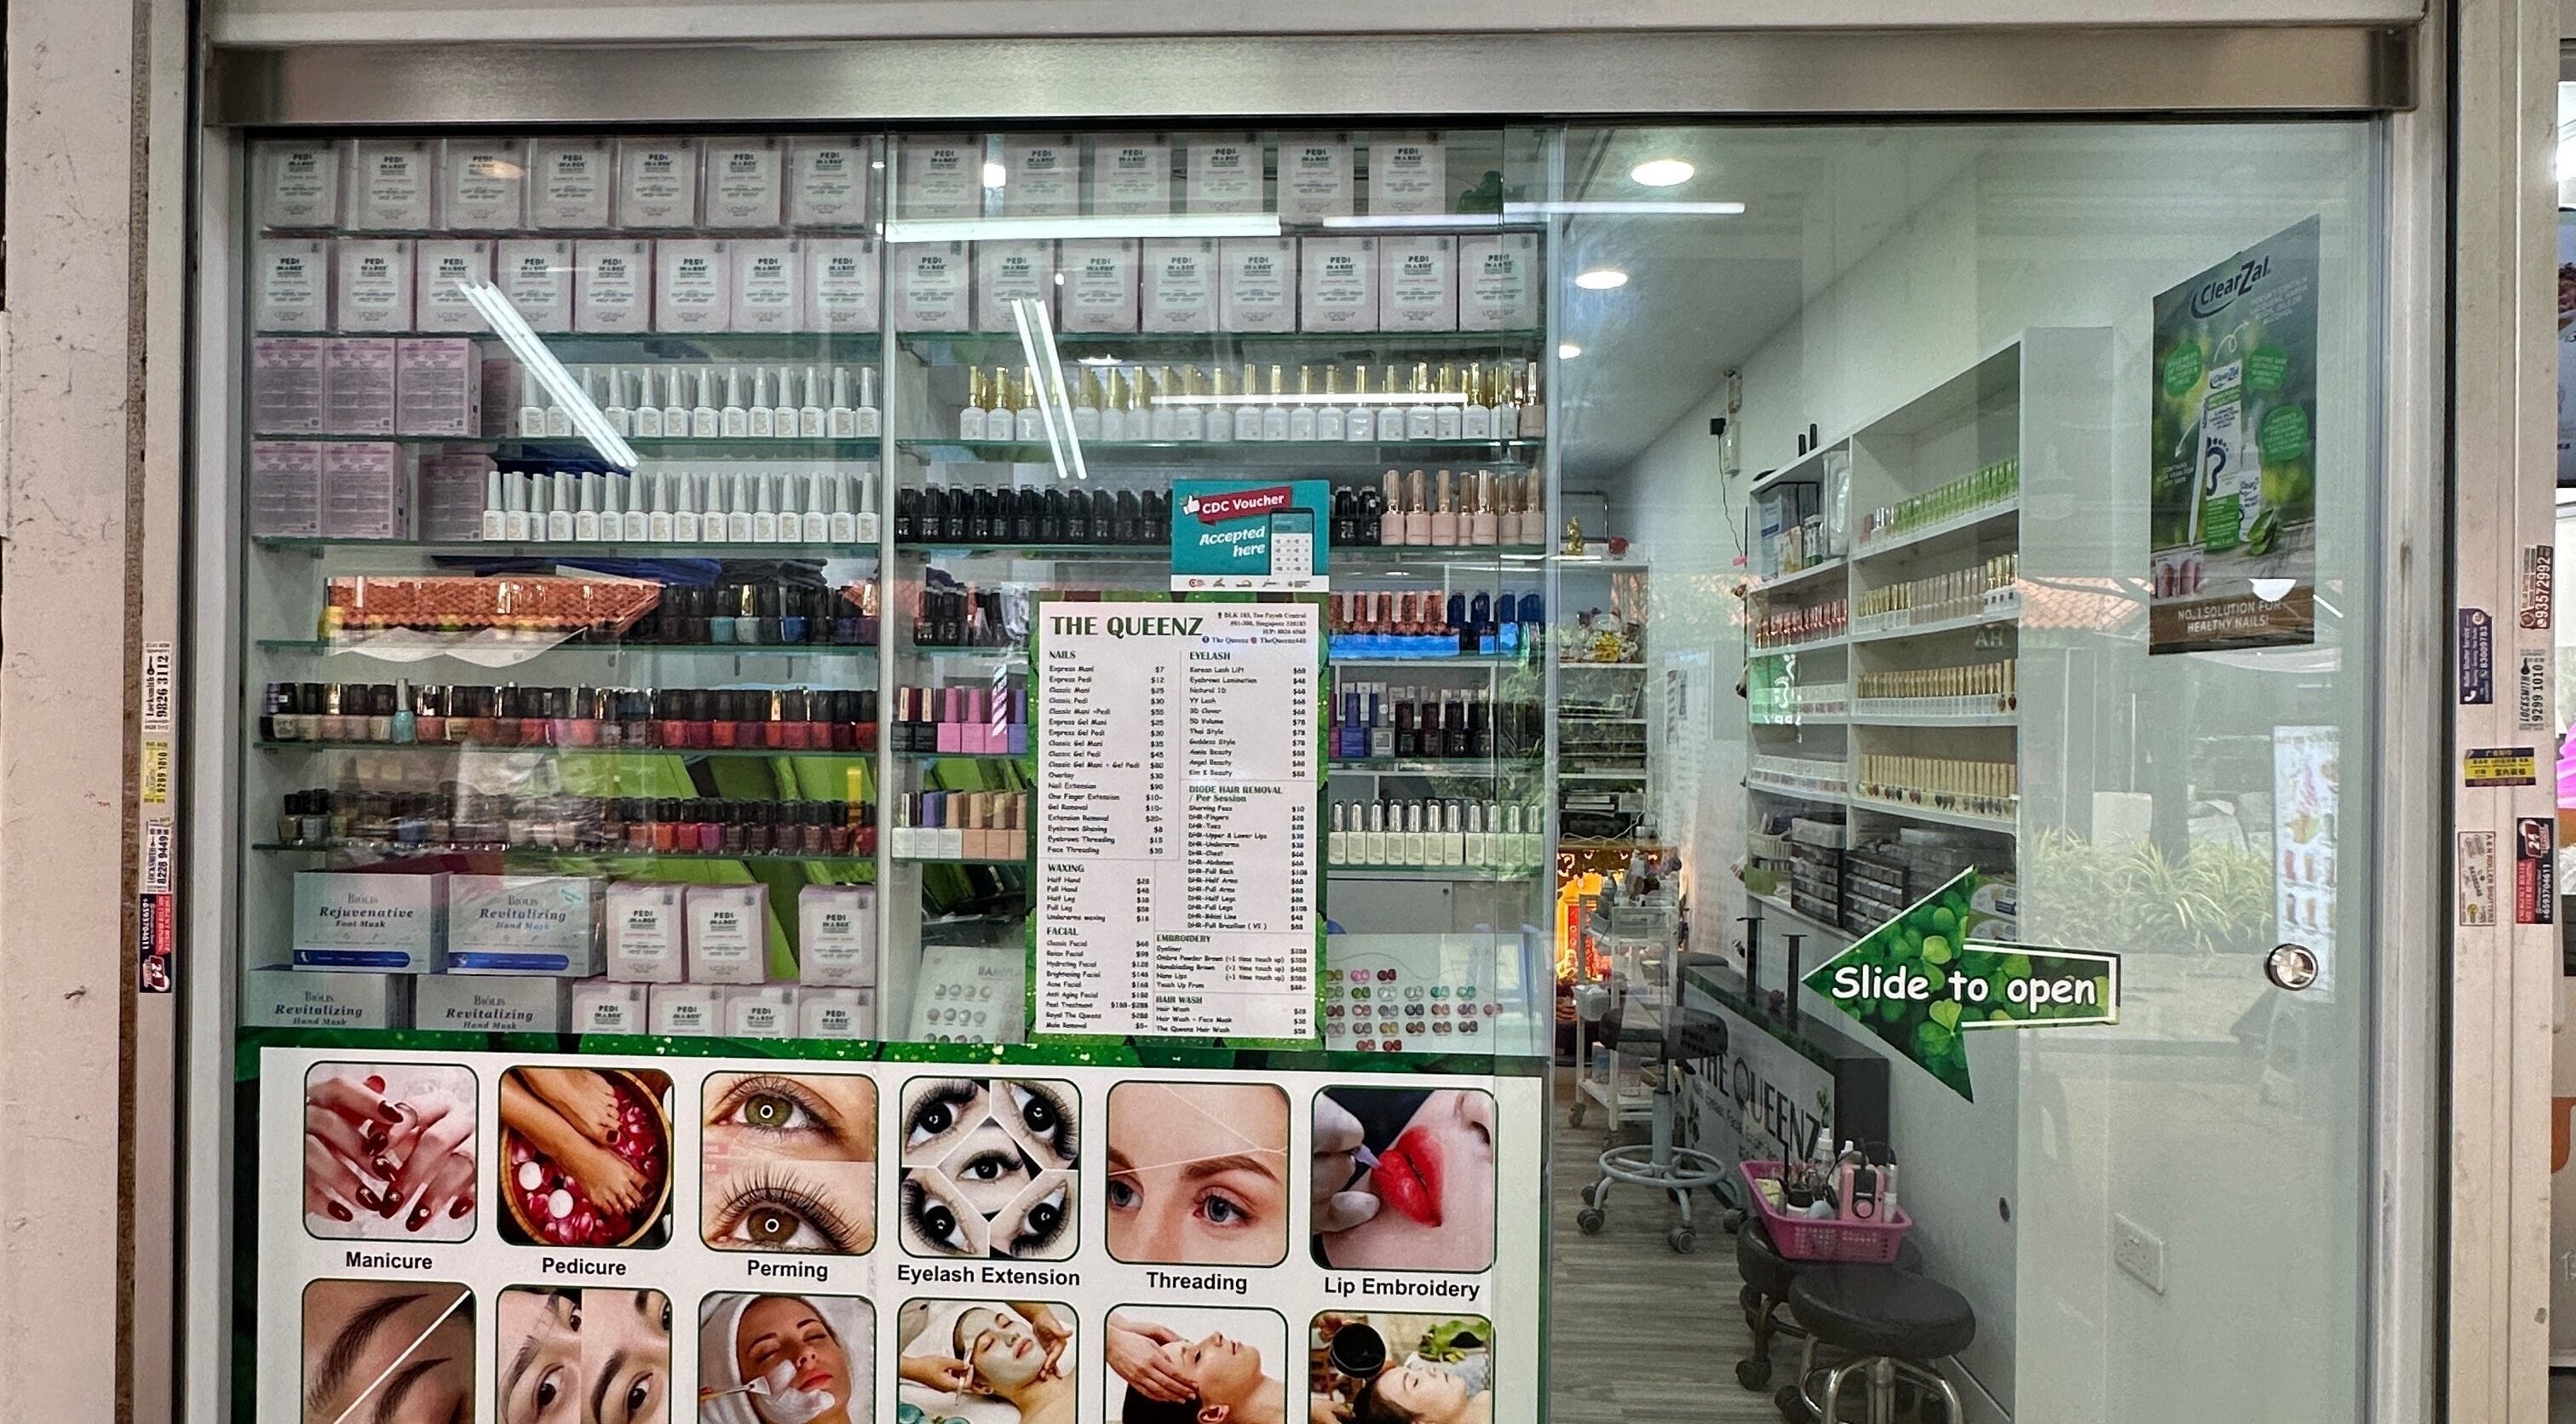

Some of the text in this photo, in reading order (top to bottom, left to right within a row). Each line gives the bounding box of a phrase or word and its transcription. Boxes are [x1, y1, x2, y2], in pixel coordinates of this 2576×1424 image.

[2200, 256, 2269, 306] ClearZal
[1202, 495, 1285, 514] CDC Voucher
[1199, 525, 1266, 546] Accepted
[1233, 543, 1266, 558] here
[2535, 556, 2550, 618] 93572992
[2204, 600, 2281, 618] SOLUTION FOR
[1050, 617, 1204, 639] THE QUEENZ
[2188, 615, 2269, 634] HEALTHY NAILS!
[1049, 651, 1076, 659] NAILS
[1190, 652, 1231, 660] EYELASH
[146, 676, 155, 716] Locksmith
[156, 655, 169, 718] 9826 3112
[2532, 664, 2544, 721] 9299 1010
[2520, 673, 2532, 722] LOCKSMITH
[1189, 785, 1216, 794] DIODE
[2527, 833, 2540, 851] 24
[1048, 864, 1085, 873] WAXING
[319, 906, 414, 919] Rejuvenative
[480, 908, 566, 922] Revitalizing
[1046, 927, 1079, 936] FACIAL
[1831, 963, 2096, 1013] Slide to open
[275, 1004, 363, 1018] Revitalizing
[446, 1008, 533, 1021] Revitalizing
[345, 1250, 433, 1271] Manicure
[541, 1256, 627, 1277] Pedicure
[746, 1259, 829, 1283] Perming
[897, 1265, 1081, 1288] Eyelash Extension
[1146, 1271, 1248, 1295] Threading
[1324, 1276, 1481, 1301] Lip Embroidery
